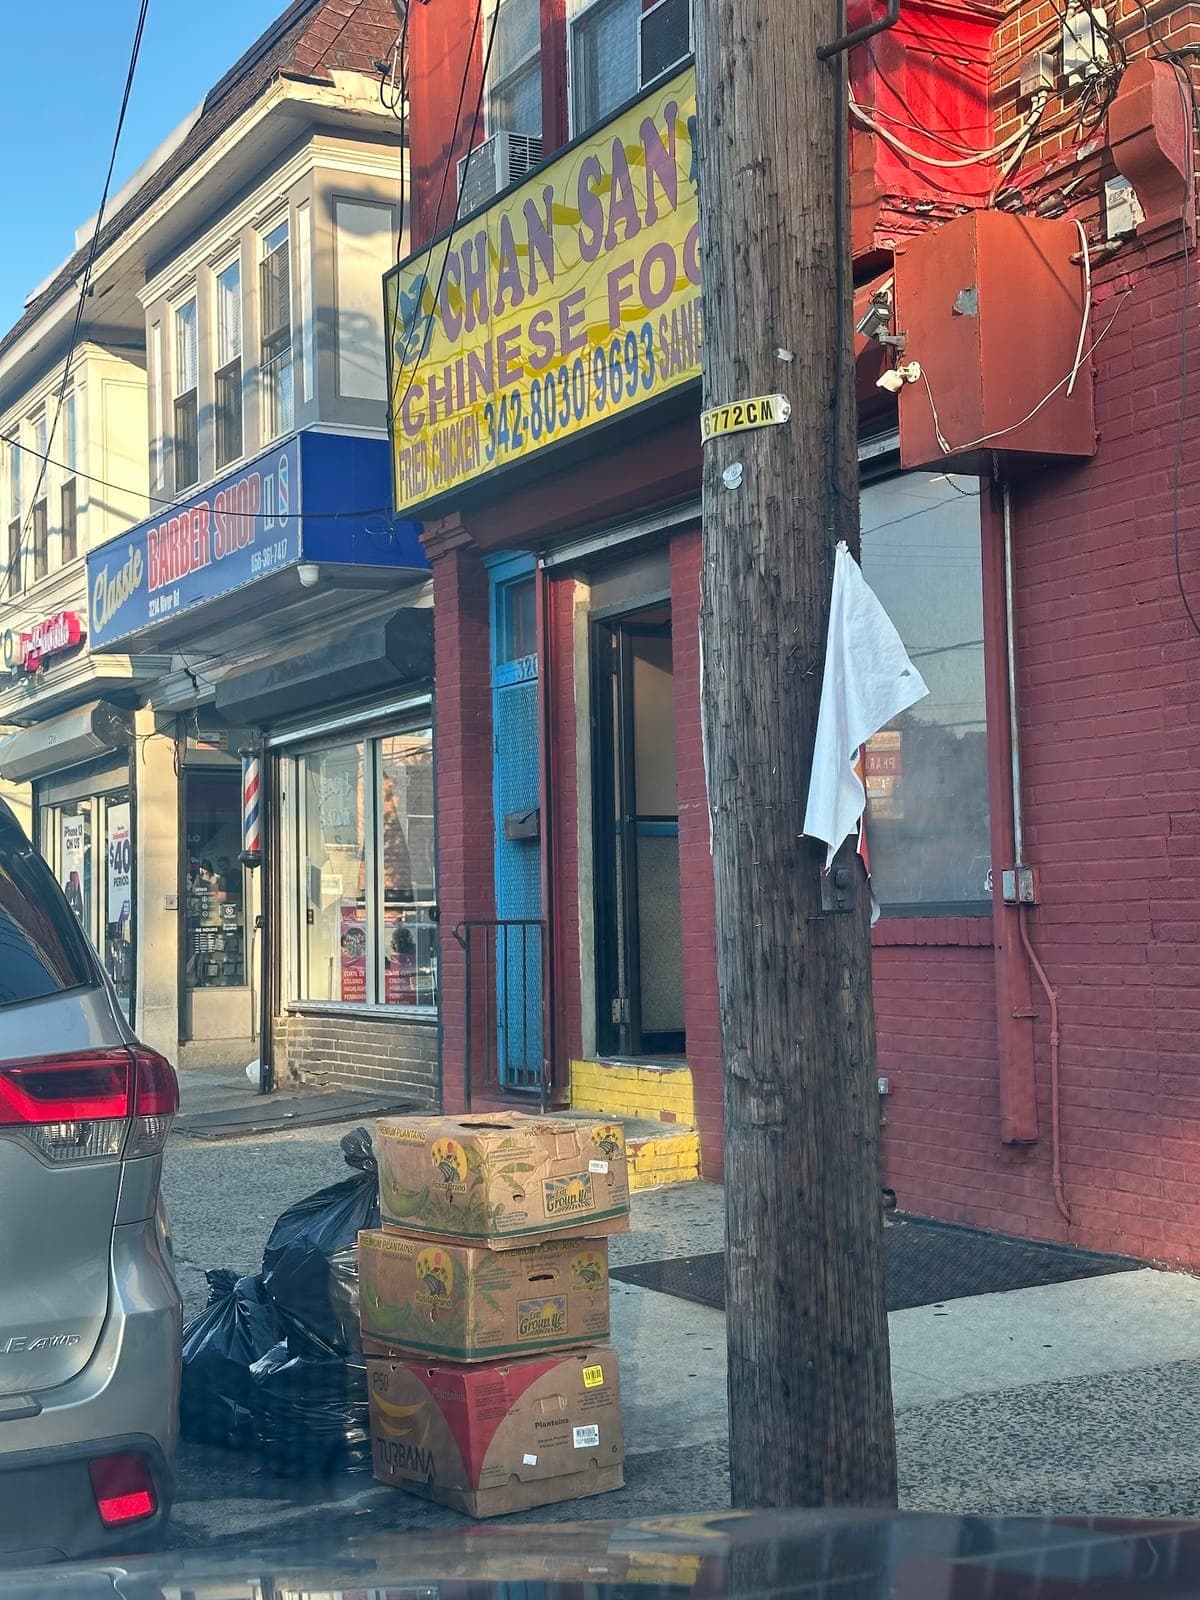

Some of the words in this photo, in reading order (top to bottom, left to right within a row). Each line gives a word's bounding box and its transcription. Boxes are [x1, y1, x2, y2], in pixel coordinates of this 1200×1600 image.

[440, 185, 554, 343] CHAN
[578, 100, 679, 262] SAN
[401, 287, 588, 437] CHINESE
[702, 400, 774, 436] 6772CM
[398, 440, 427, 502] FRIED
[432, 411, 480, 489] CHICKEN
[147, 500, 212, 592] BARBER
[214, 471, 261, 561] SHOP
[109, 839, 131, 874] $40
[546, 1192, 577, 1212] Group
[360, 1237, 381, 1248] PREMIUM
[382, 1240, 414, 1254] PLANTAINS
[27, 1333, 81, 1351] AWD
[520, 1316, 551, 1334] Group
[373, 1371, 389, 1392] P50
[534, 1418, 569, 1430] Plantains
[377, 1437, 437, 1479] TURBANA
